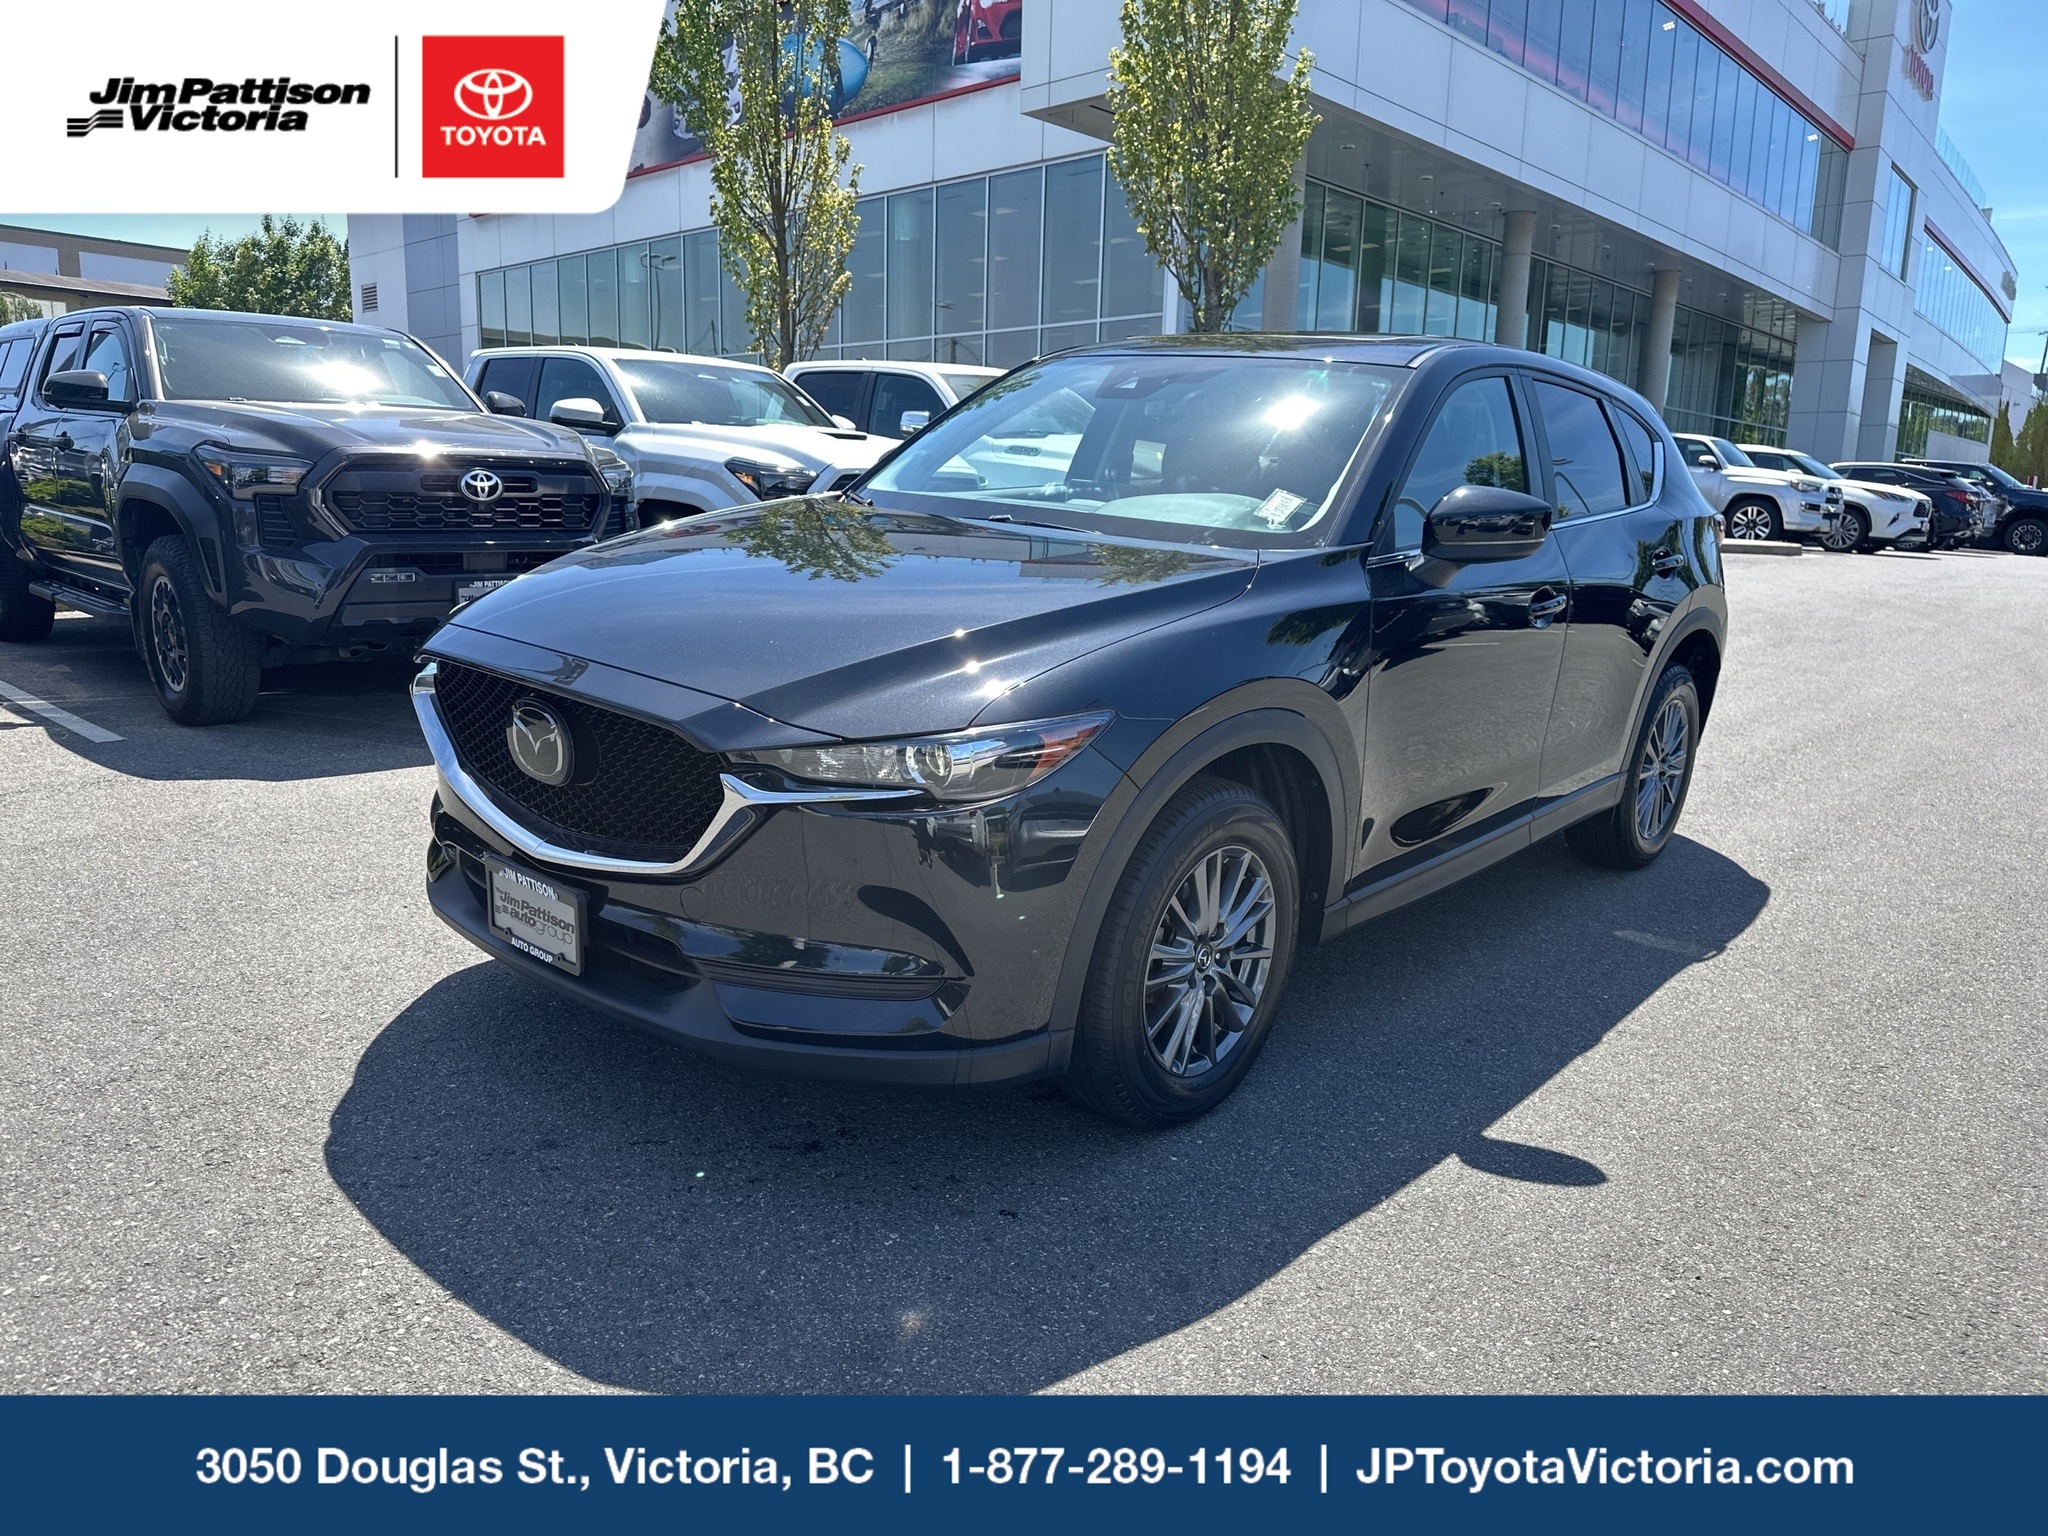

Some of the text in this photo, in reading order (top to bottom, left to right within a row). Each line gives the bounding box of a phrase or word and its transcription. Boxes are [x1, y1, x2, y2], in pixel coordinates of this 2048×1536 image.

[504, 866, 554, 900] JIM PATTISON
[511, 936, 553, 963] AUTO GROUP
